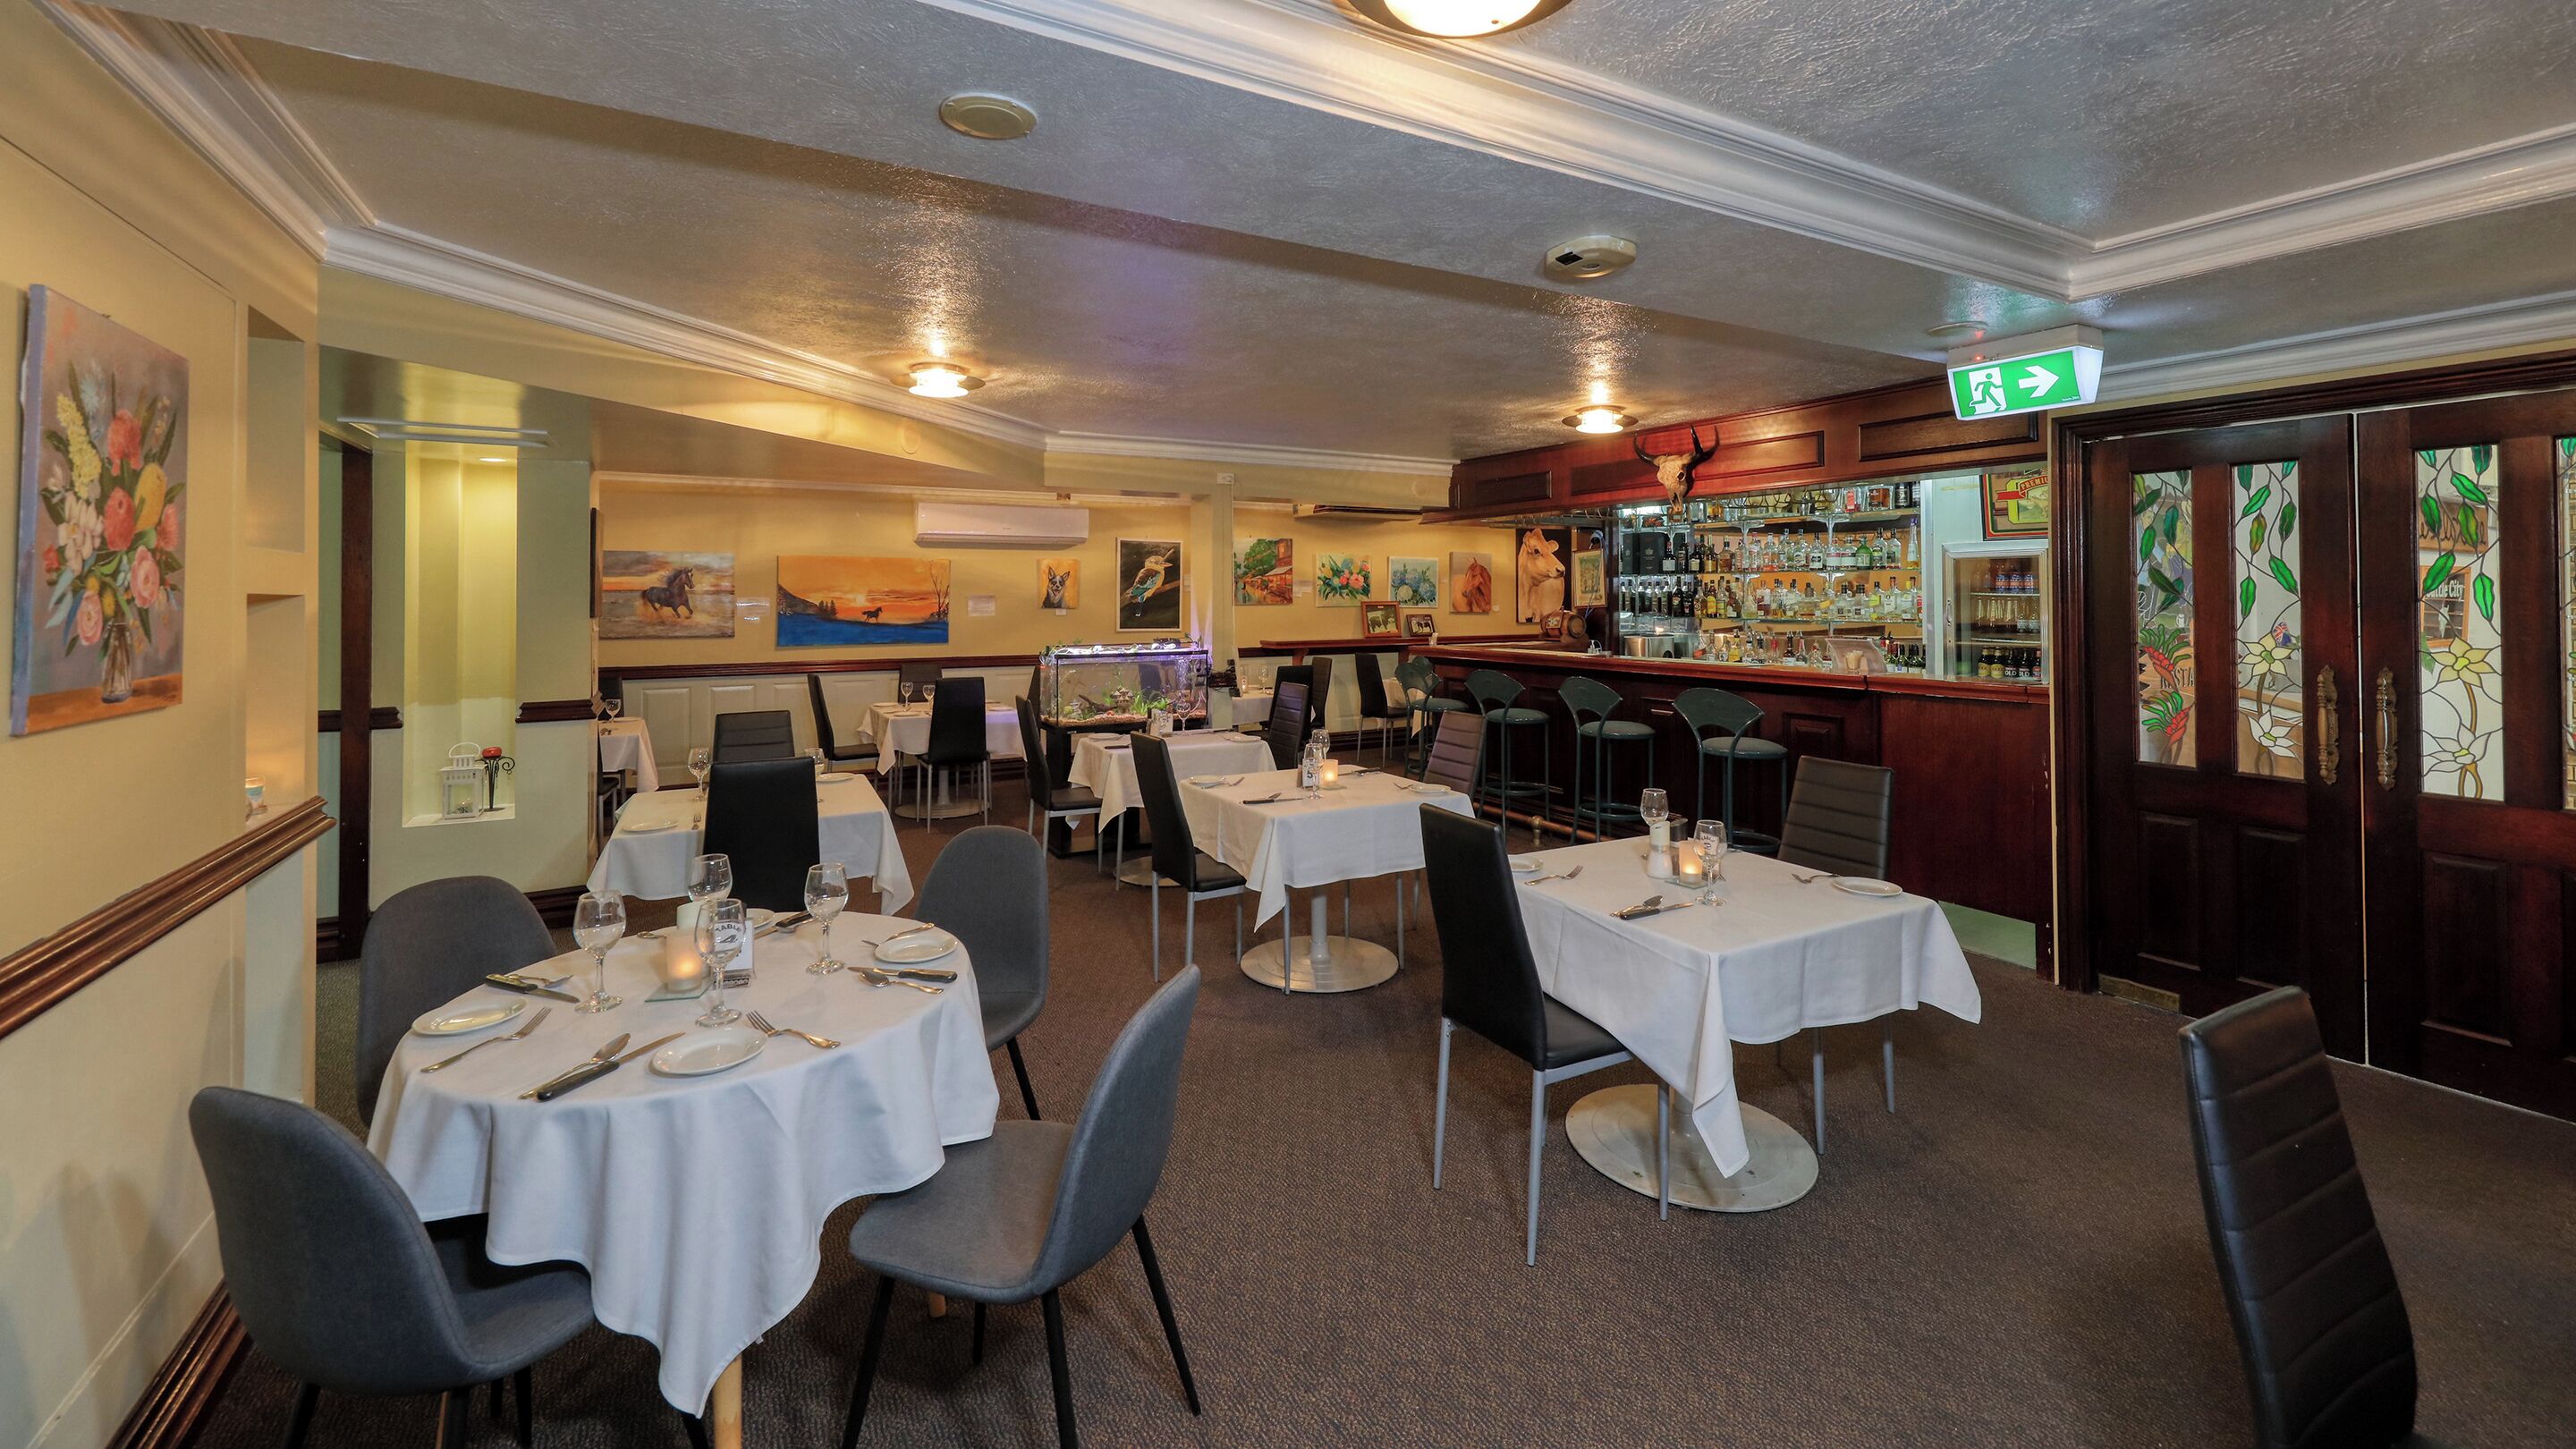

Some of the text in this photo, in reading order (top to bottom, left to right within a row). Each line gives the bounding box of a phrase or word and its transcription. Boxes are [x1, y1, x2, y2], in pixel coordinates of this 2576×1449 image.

[2425, 580, 2463, 602] attle City
[1307, 770, 1314, 779] 5
